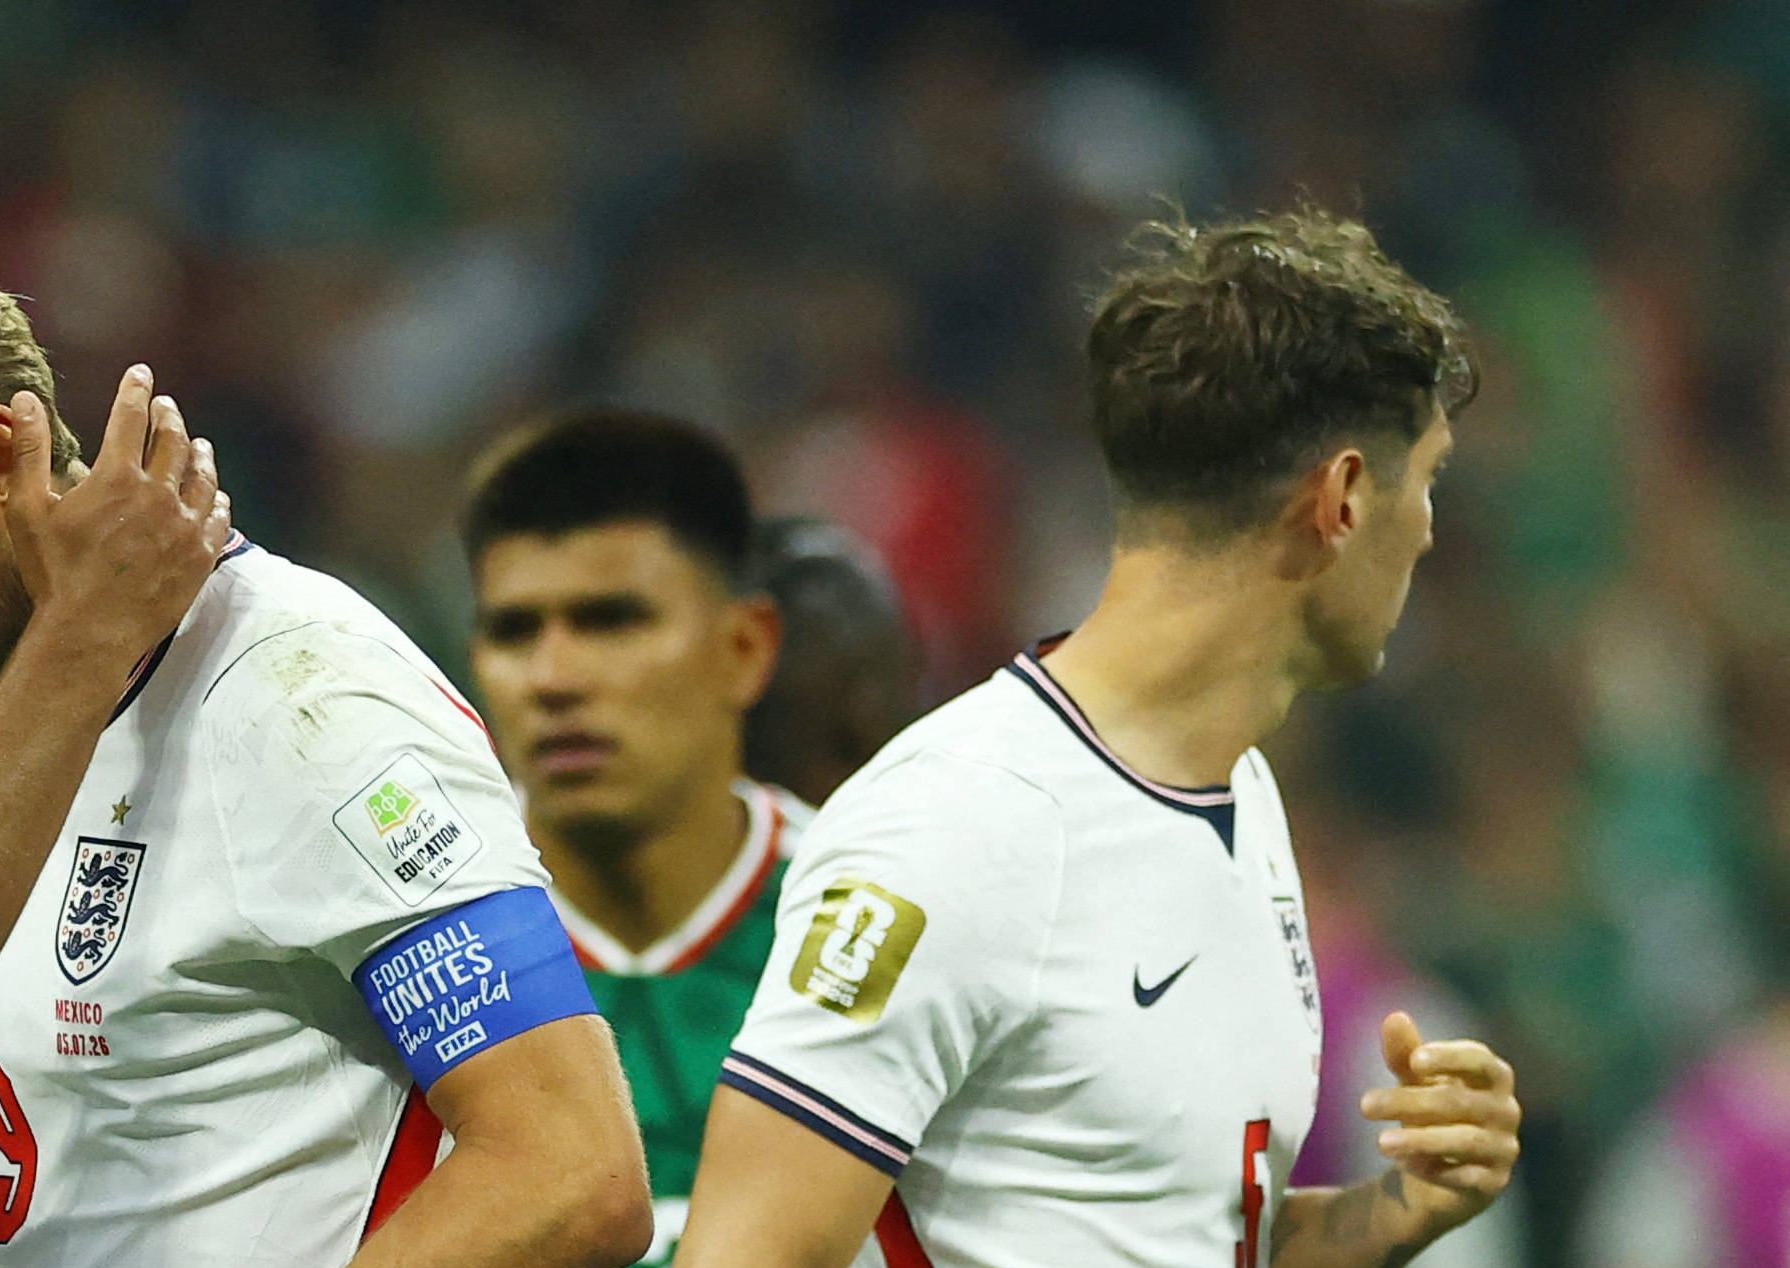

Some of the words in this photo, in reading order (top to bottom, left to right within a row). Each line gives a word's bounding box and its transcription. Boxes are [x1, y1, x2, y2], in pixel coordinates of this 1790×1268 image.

[386, 825, 422, 859] Unite
[416, 808, 437, 833] For
[394, 821, 462, 883] EDUCATION
[429, 857, 453, 879] FIFA
[370, 920, 480, 994] FOOTBALL
[381, 942, 493, 1025] UNITES
[55, 998, 102, 1025] MEXICO
[398, 1024, 432, 1057] the
[427, 970, 511, 1032] World
[56, 1032, 110, 1057] 05.07.26
[439, 1027, 482, 1059] FIFA
